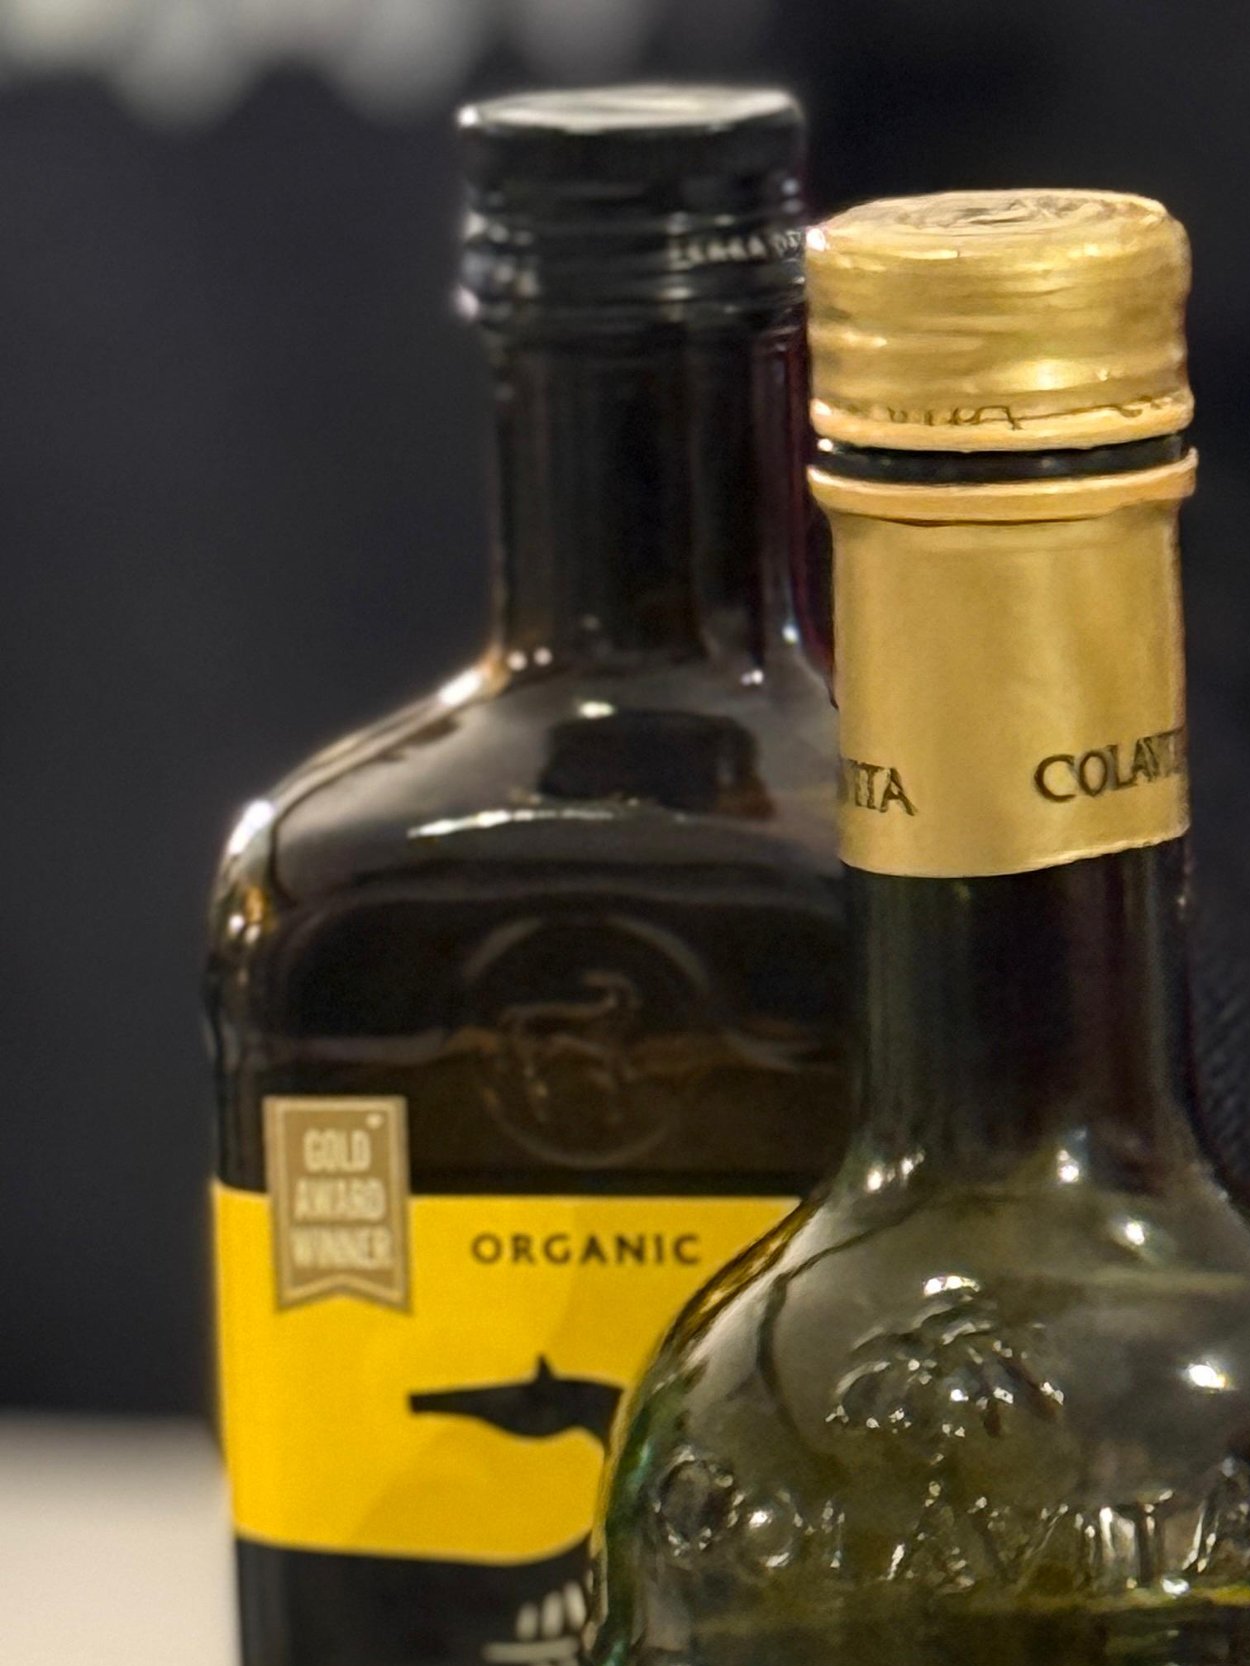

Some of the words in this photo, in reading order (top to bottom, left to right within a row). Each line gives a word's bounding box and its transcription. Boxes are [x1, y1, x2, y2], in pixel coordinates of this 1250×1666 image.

[303, 1127, 371, 1174] GOLD
[294, 1177, 387, 1222] AWARD
[289, 1223, 394, 1271] WINNER
[471, 1232, 702, 1267] ORGANIC
